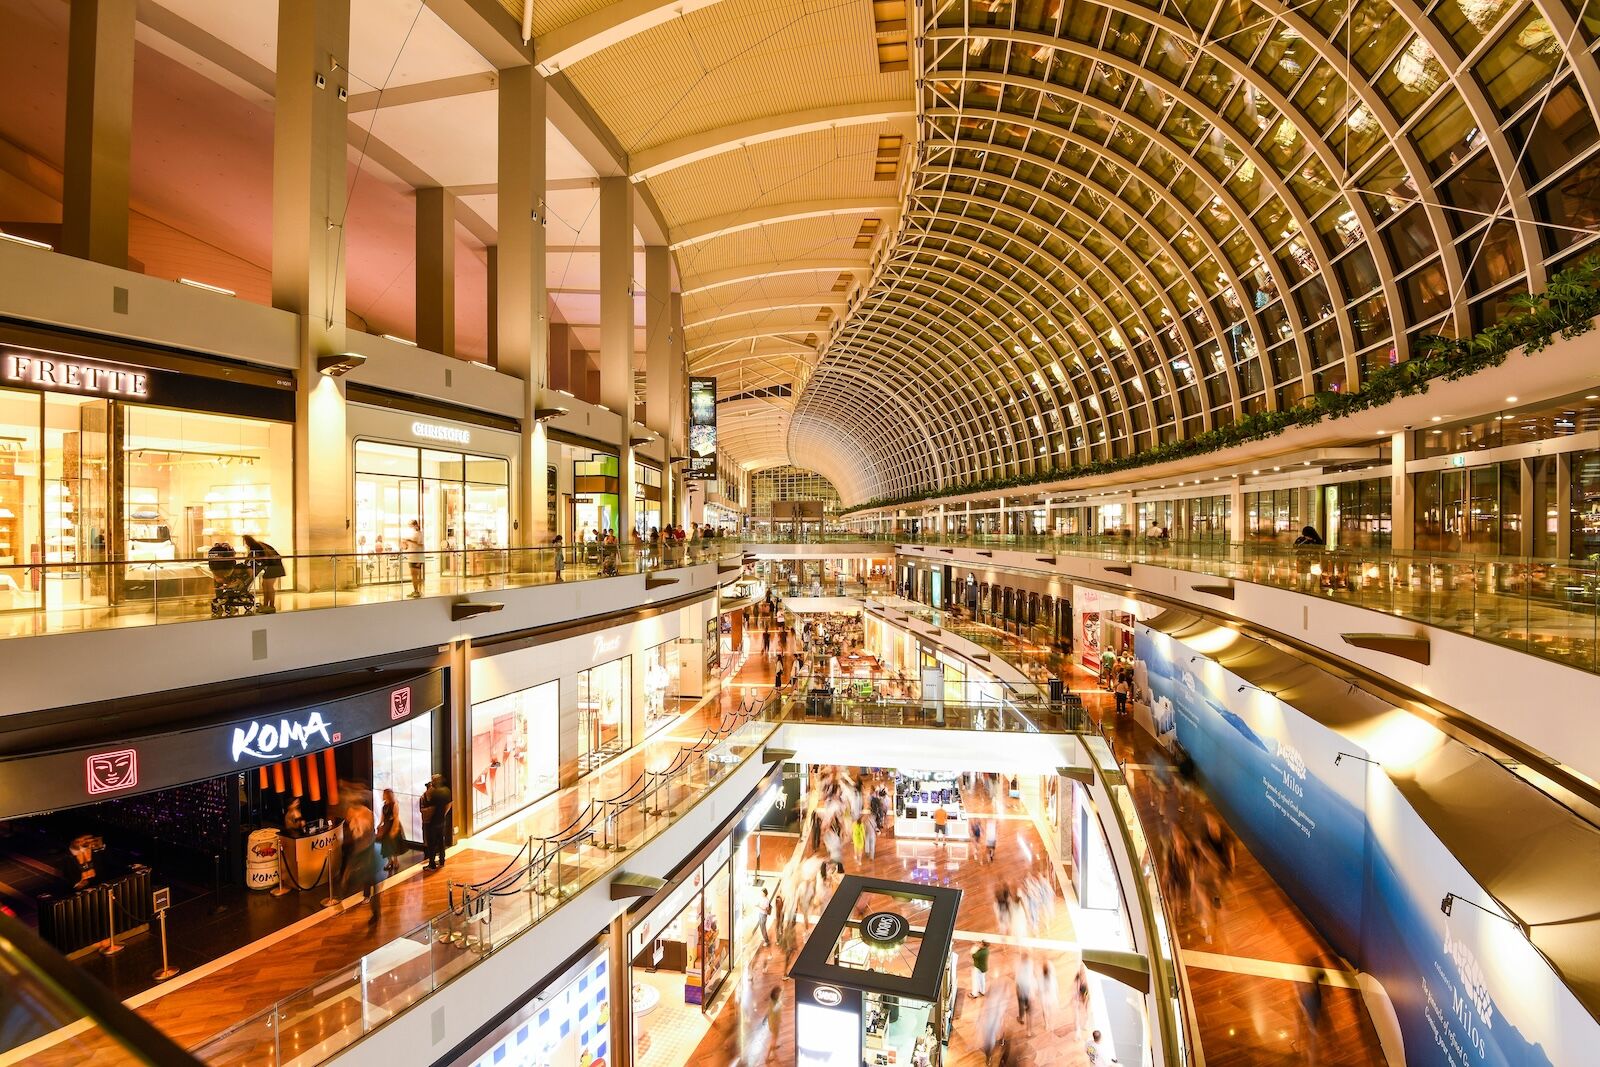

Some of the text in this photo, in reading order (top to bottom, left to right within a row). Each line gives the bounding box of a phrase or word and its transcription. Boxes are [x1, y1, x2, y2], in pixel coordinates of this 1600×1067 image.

[8, 355, 147, 395] FRETTE
[232, 711, 332, 762] KOMA
[1282, 770, 1303, 797] Milos
[311, 832, 338, 851] KOMA
[252, 870, 280, 882] KOMA
[1452, 985, 1486, 1060] Milos
